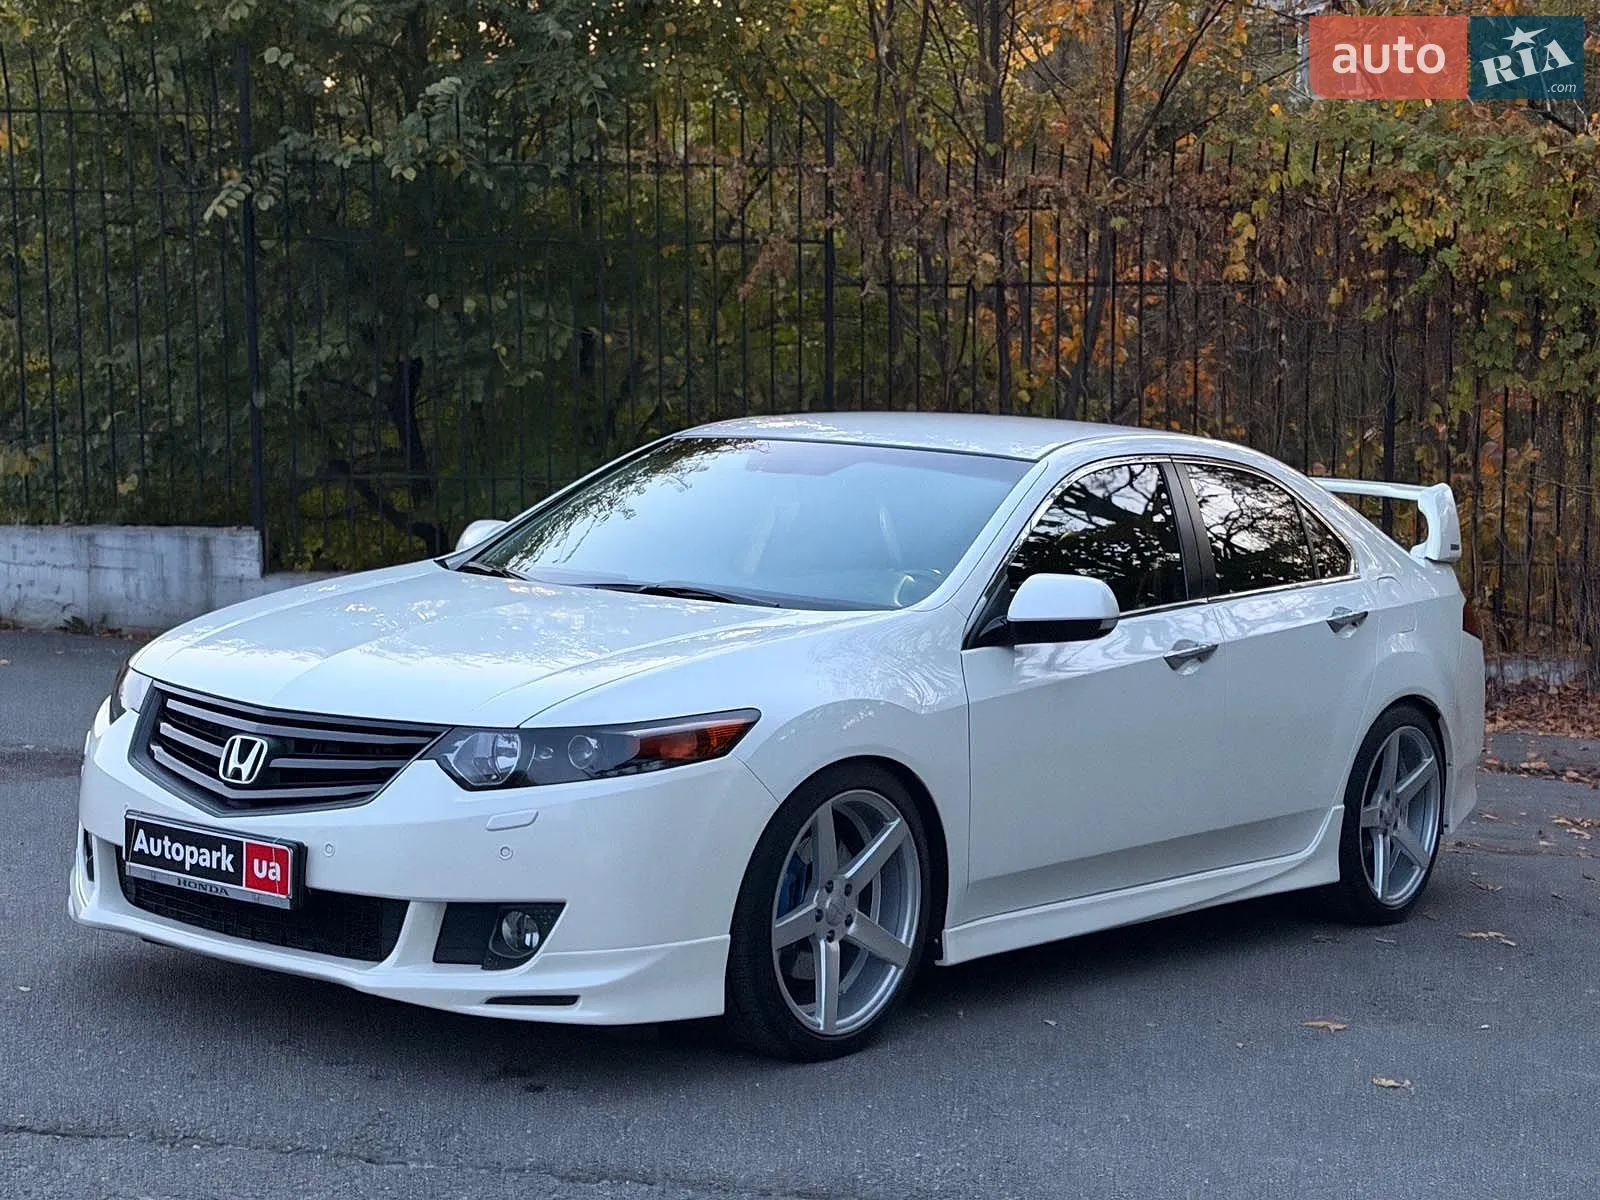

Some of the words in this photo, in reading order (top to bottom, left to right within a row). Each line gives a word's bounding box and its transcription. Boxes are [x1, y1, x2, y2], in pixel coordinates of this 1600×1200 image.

[133, 829, 235, 872] Autopark
[253, 857, 281, 882] ua
[177, 878, 229, 896] HONDA
